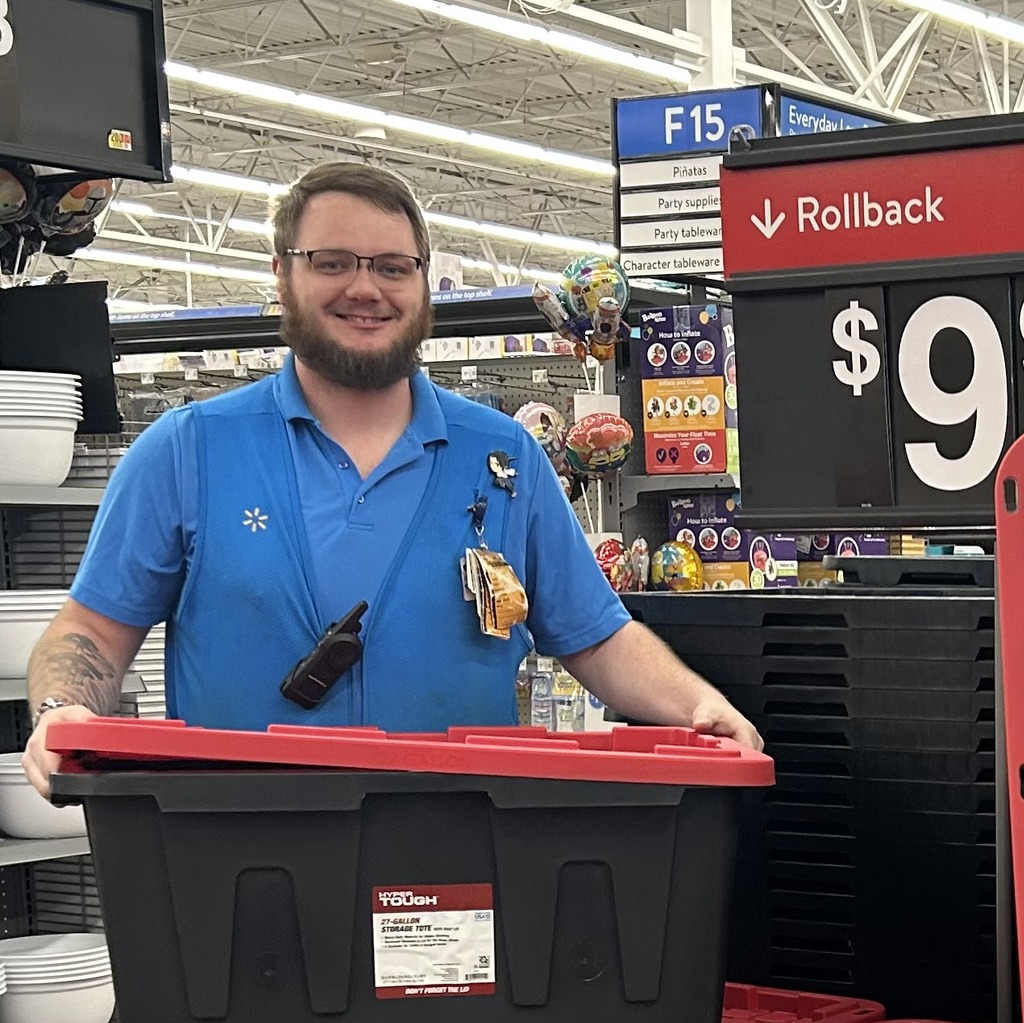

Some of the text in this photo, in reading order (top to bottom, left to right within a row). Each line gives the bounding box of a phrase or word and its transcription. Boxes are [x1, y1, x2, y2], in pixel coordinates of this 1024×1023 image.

[664, 103, 725, 145] F15
[789, 104, 838, 133] Everyday
[673, 166, 707, 178] Piñatas
[658, 195, 721, 211] Party supplie
[797, 187, 945, 233] Rollback
[654, 226, 722, 242] Party tablewar
[623, 257, 720, 271] Character tableware
[379, 896, 438, 906] TOUGH
